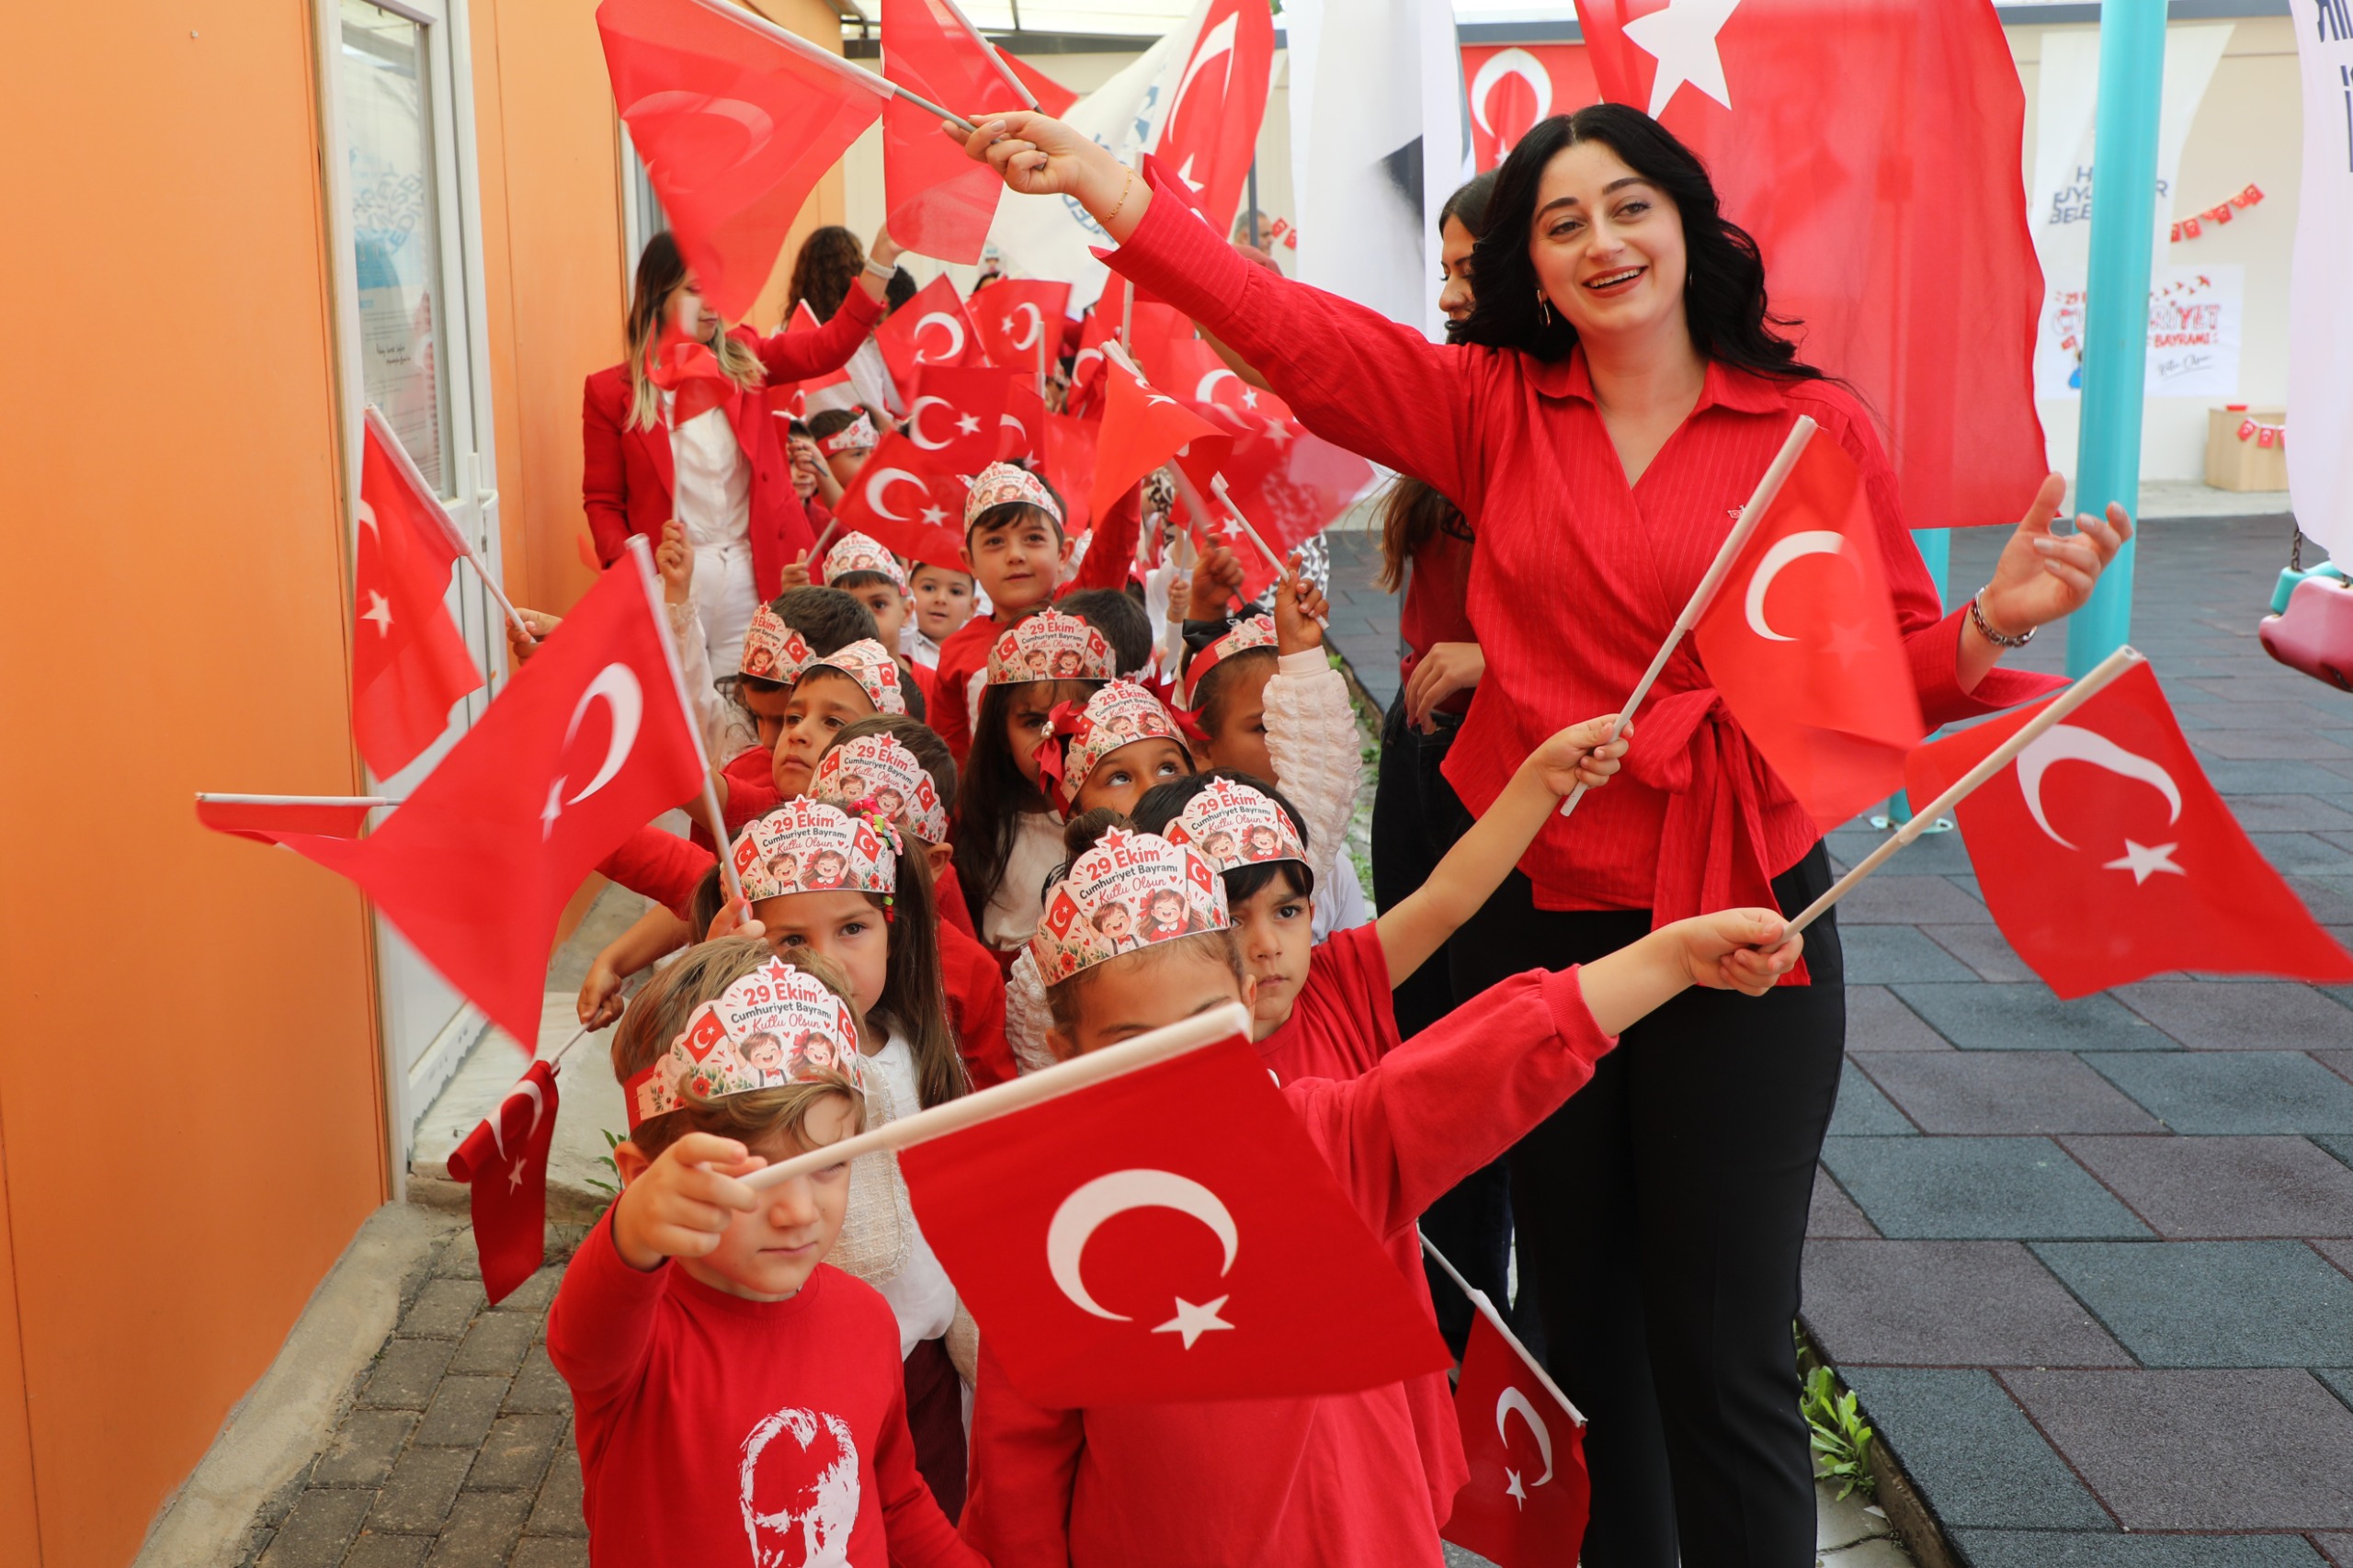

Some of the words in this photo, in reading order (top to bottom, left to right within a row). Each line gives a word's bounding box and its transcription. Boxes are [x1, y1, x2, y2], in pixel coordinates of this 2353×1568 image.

[758, 616, 776, 631] Ekim
[1029, 624, 1044, 634] 29
[1048, 622, 1074, 632] Ekim
[1022, 634, 1057, 644] Cumhuriyet
[1059, 632, 1083, 642] Bayramı
[1099, 693, 1117, 706] 29
[1118, 689, 1148, 700] Ekim
[1096, 699, 1132, 717] Cumhuriyet
[1109, 708, 1130, 718] Kutlu
[858, 745, 875, 758] 29
[878, 749, 908, 770] Ekim
[845, 757, 886, 770] Cumhuriyet
[888, 767, 914, 785] Bayramı
[852, 766, 875, 778] Kutlu
[878, 771, 901, 788] Olsun
[1198, 799, 1219, 815] 29
[1221, 794, 1256, 807] Ekim
[773, 817, 793, 834] 29
[797, 814, 834, 828] Ekim
[1191, 807, 1238, 830] Cumhuriyet
[1241, 806, 1270, 816] Bayramı
[1209, 820, 1233, 833] Kutlu
[1236, 814, 1262, 824] Olsun
[763, 830, 810, 846] Cumhuriyet
[813, 828, 847, 839] Bayramı
[777, 839, 802, 854] Kutlu
[805, 837, 834, 848] Olsun
[1086, 858, 1111, 881] 29
[1114, 847, 1160, 869] Ekim
[1080, 868, 1135, 900] Cumhuriyet
[1138, 865, 1177, 876] Bayramı
[1098, 884, 1130, 903] Kutlu
[1132, 877, 1166, 891] Olsun
[743, 985, 771, 1006] 29
[775, 983, 817, 1003] Ekim
[731, 1003, 793, 1023] Cumhuriyet
[796, 1002, 831, 1019] Bayramı
[753, 1015, 786, 1032] Kutlu
[789, 1014, 821, 1029] Olsun
